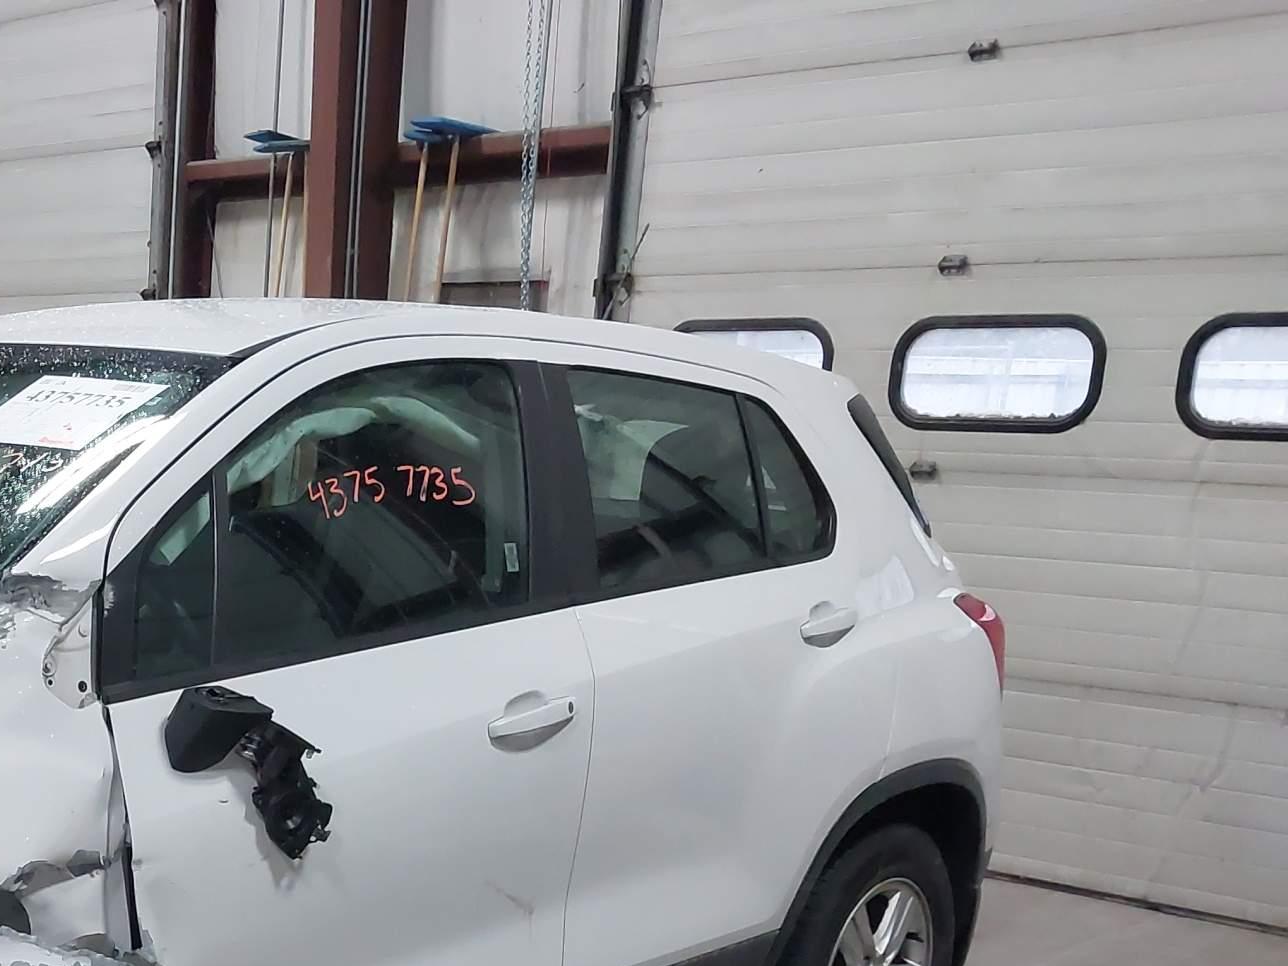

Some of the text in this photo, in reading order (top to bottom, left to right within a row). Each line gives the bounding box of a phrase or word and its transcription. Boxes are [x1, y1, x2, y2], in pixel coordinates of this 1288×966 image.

[26, 389, 133, 409] 43757735
[307, 465, 476, 519] 4375 7735
